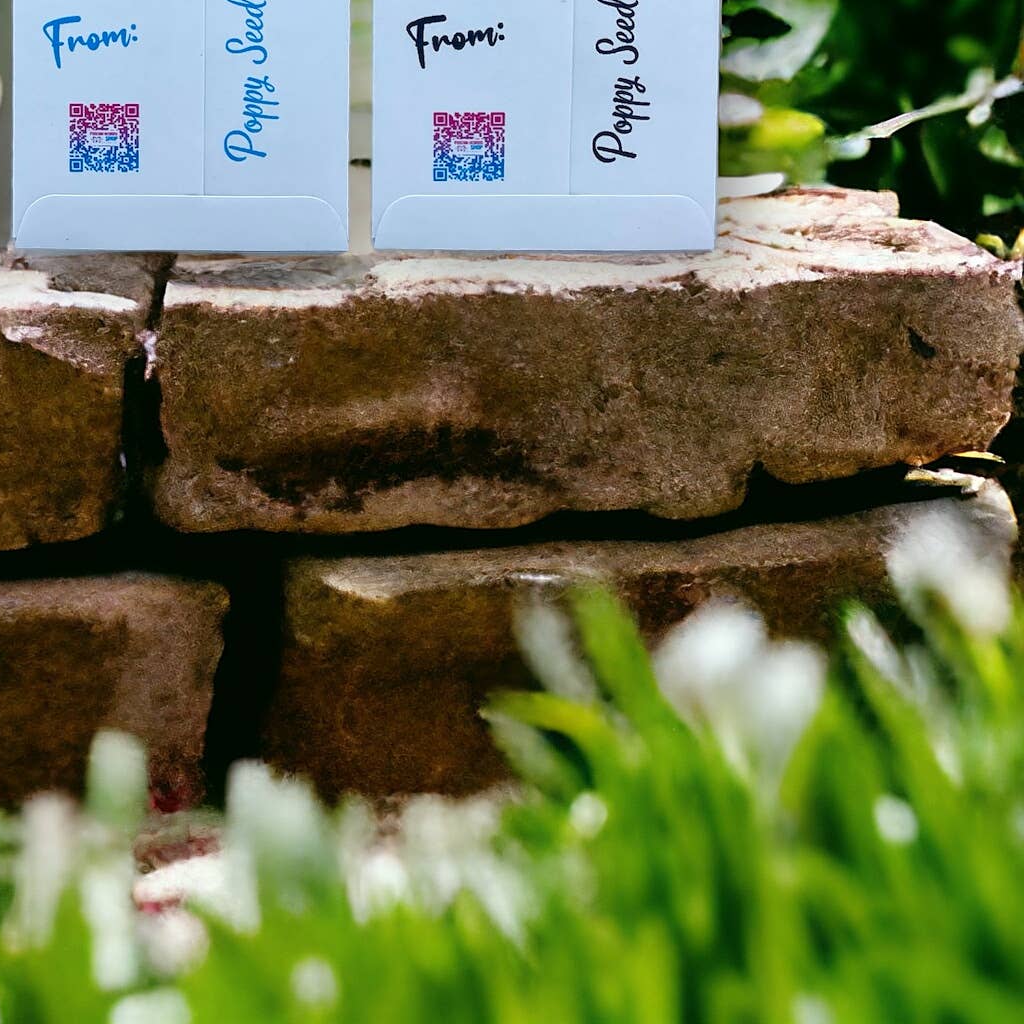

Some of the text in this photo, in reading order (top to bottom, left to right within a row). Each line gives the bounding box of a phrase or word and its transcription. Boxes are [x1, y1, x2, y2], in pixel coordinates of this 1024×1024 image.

[43, 16, 138, 69] From:
[406, 14, 505, 70] From:
[224, 75, 281, 162] Poppy
[592, 76, 652, 164] Poppy
